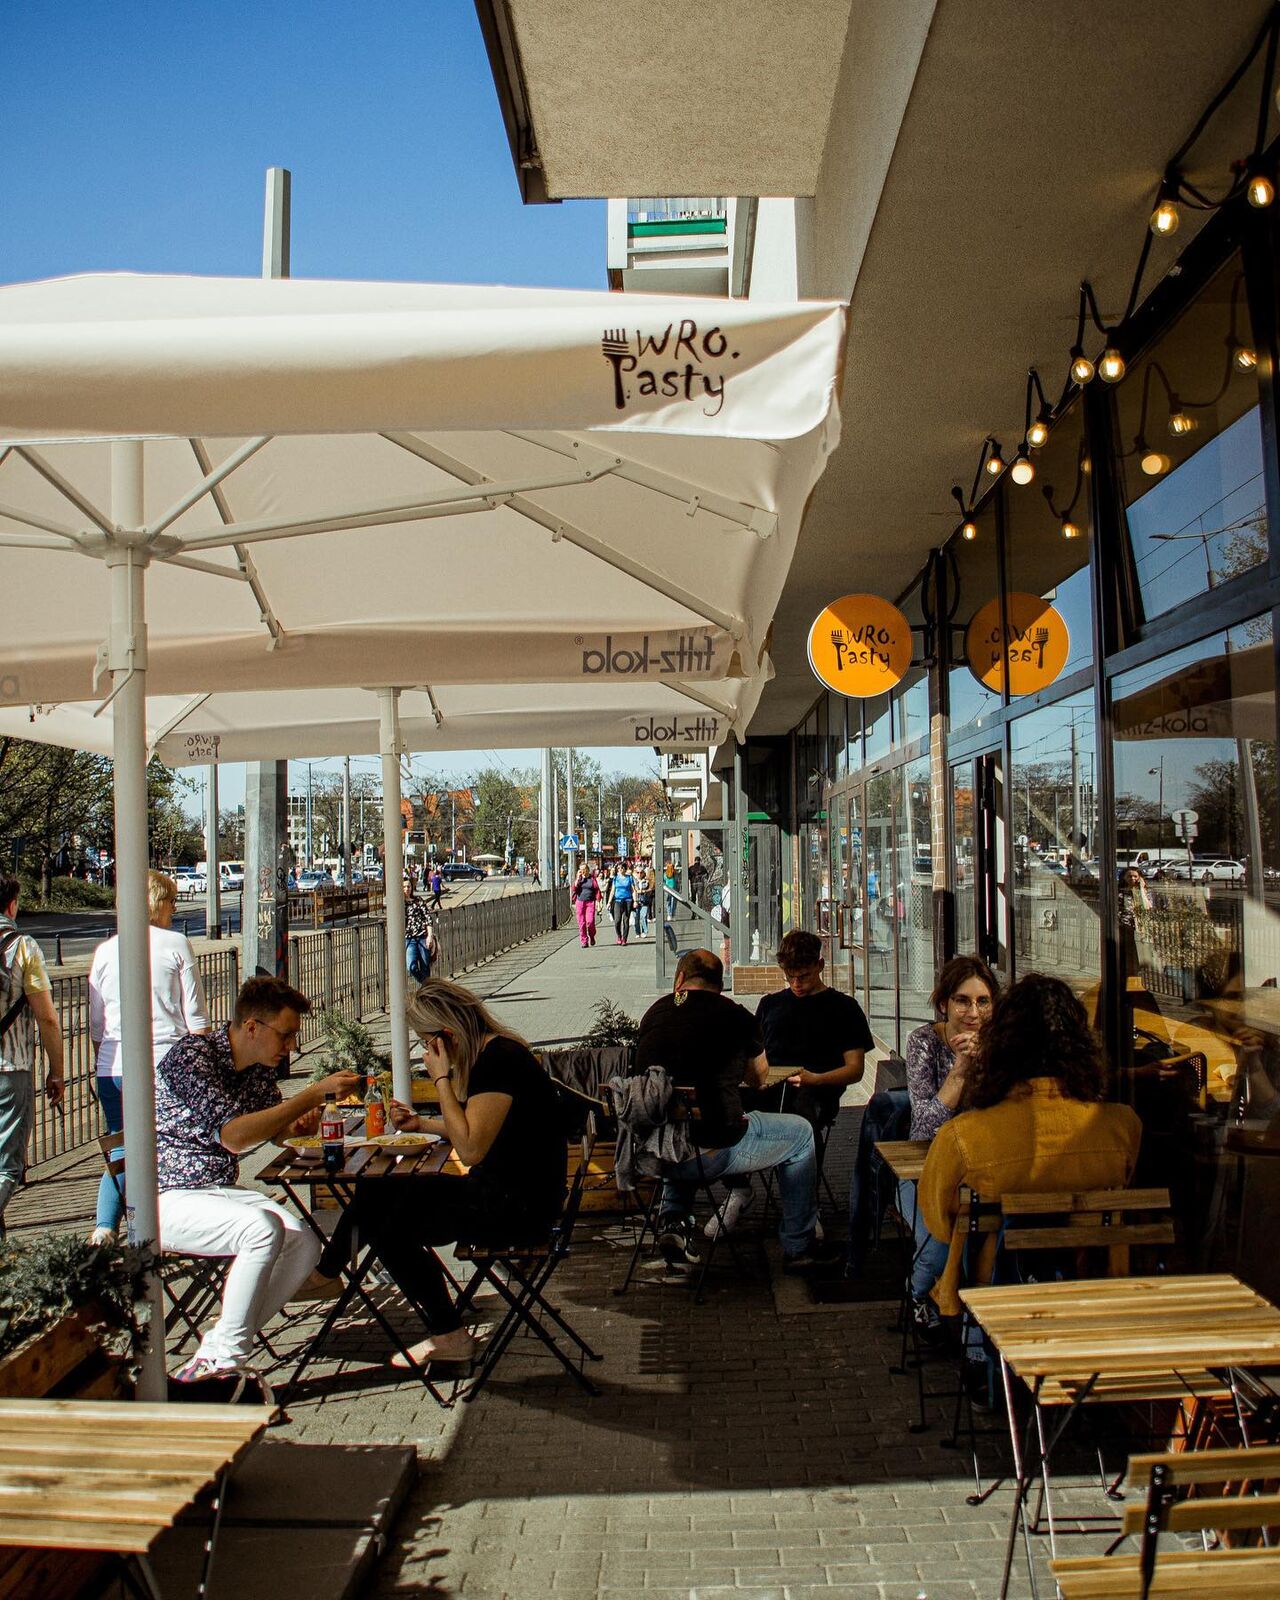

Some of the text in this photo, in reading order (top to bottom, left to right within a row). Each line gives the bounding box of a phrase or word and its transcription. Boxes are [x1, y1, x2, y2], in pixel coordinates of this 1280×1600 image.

[636, 319, 740, 363] WRO.
[602, 354, 726, 417] Pasty
[847, 624, 896, 646] WRO.
[833, 641, 890, 672] Pasty
